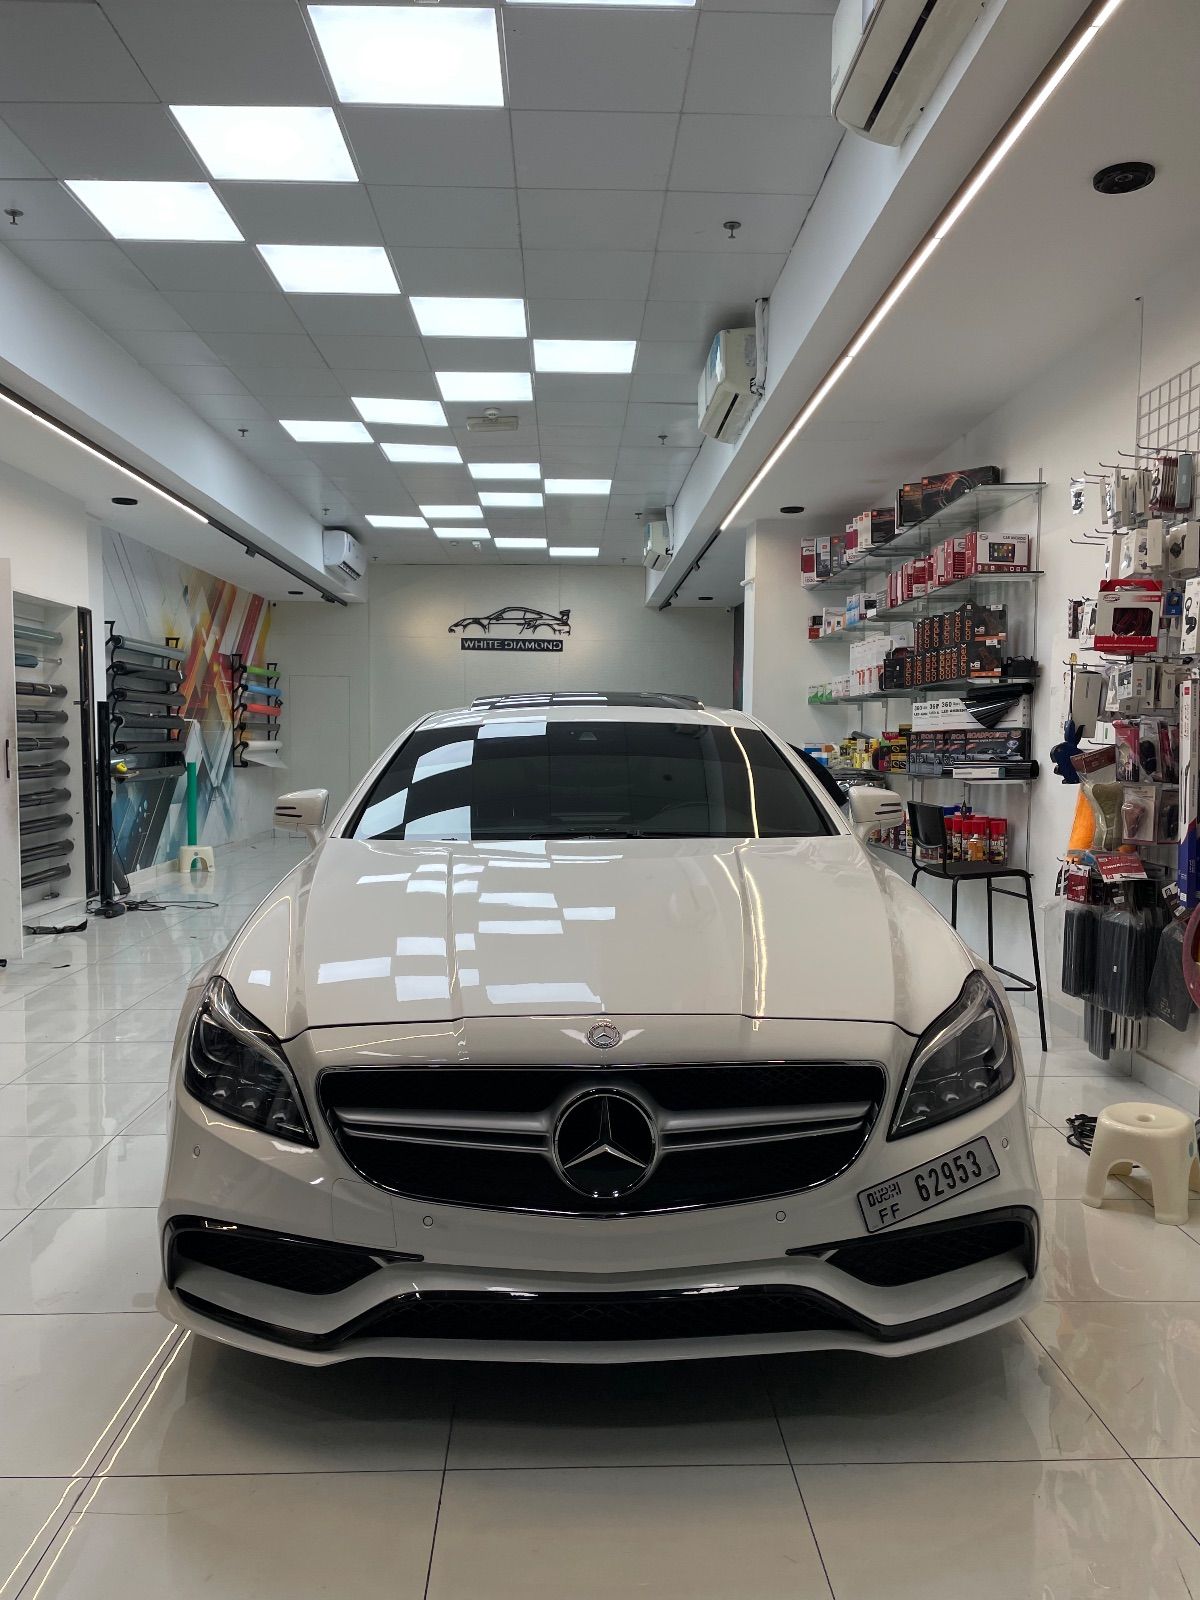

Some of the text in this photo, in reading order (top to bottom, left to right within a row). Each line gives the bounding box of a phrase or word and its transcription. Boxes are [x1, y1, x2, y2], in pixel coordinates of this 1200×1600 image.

[463, 640, 562, 650] WHITE DIAMOND
[966, 731, 1009, 739] ROADPOWER
[914, 1150, 982, 1202] 62953
[878, 1202, 900, 1224] FF
